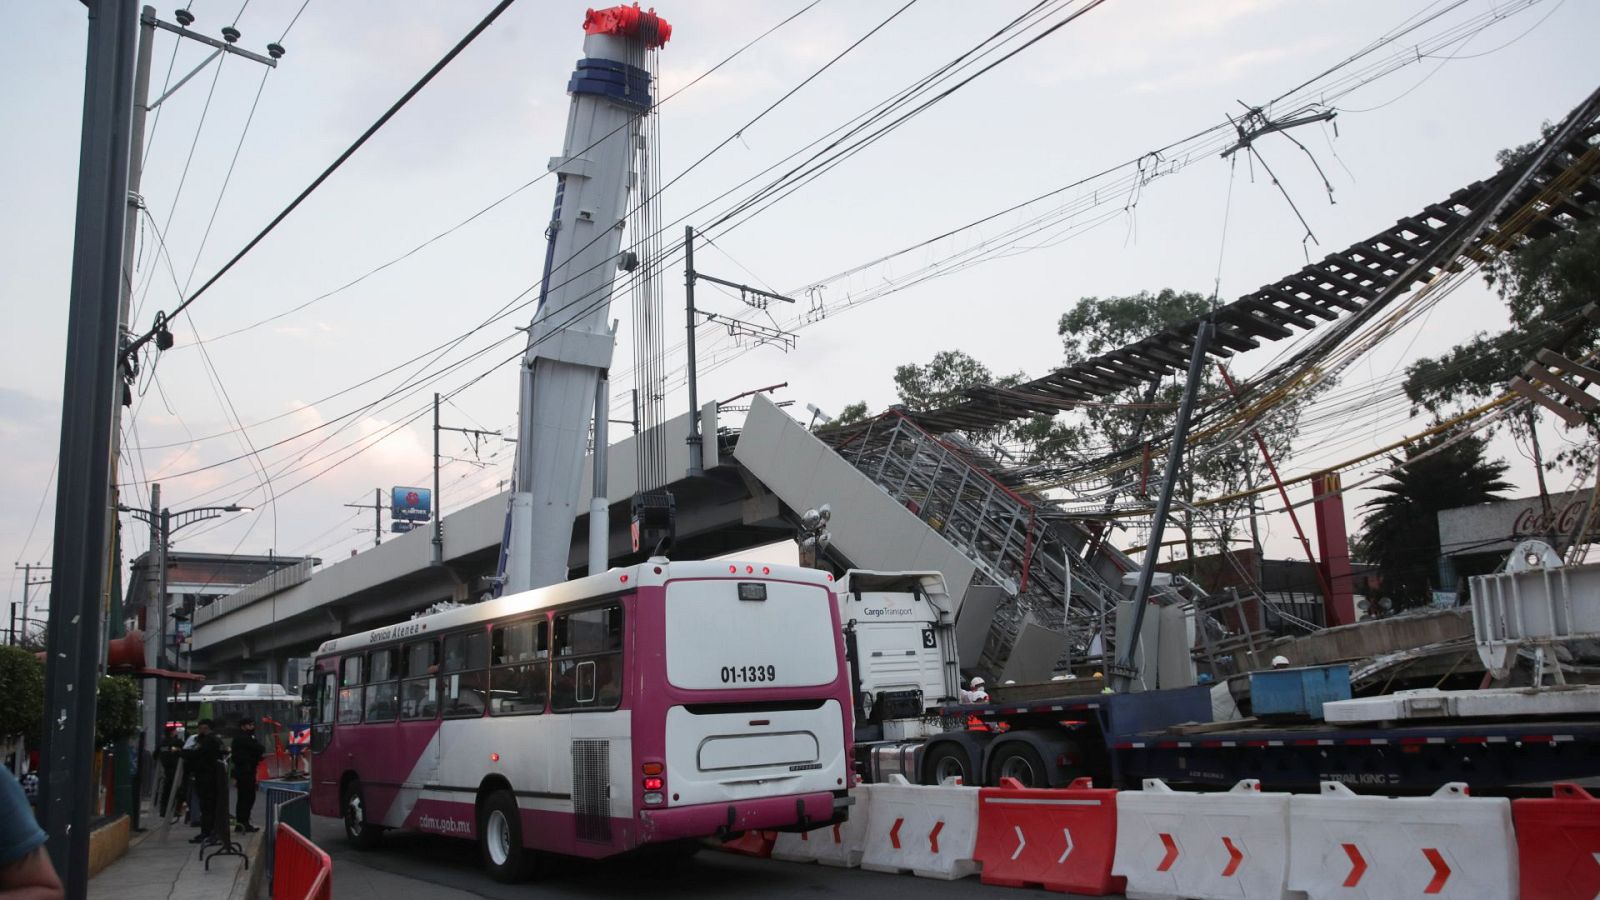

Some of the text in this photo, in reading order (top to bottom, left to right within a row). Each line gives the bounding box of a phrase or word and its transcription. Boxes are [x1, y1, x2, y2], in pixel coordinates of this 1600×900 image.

[863, 607, 913, 617] CargoTransport
[392, 623, 419, 639] Atenea
[925, 630, 935, 646] 3
[721, 665, 776, 683] 01-1339
[1329, 774, 1386, 784] TRAIL KING
[419, 814, 471, 833] cdmx.gob.mx
